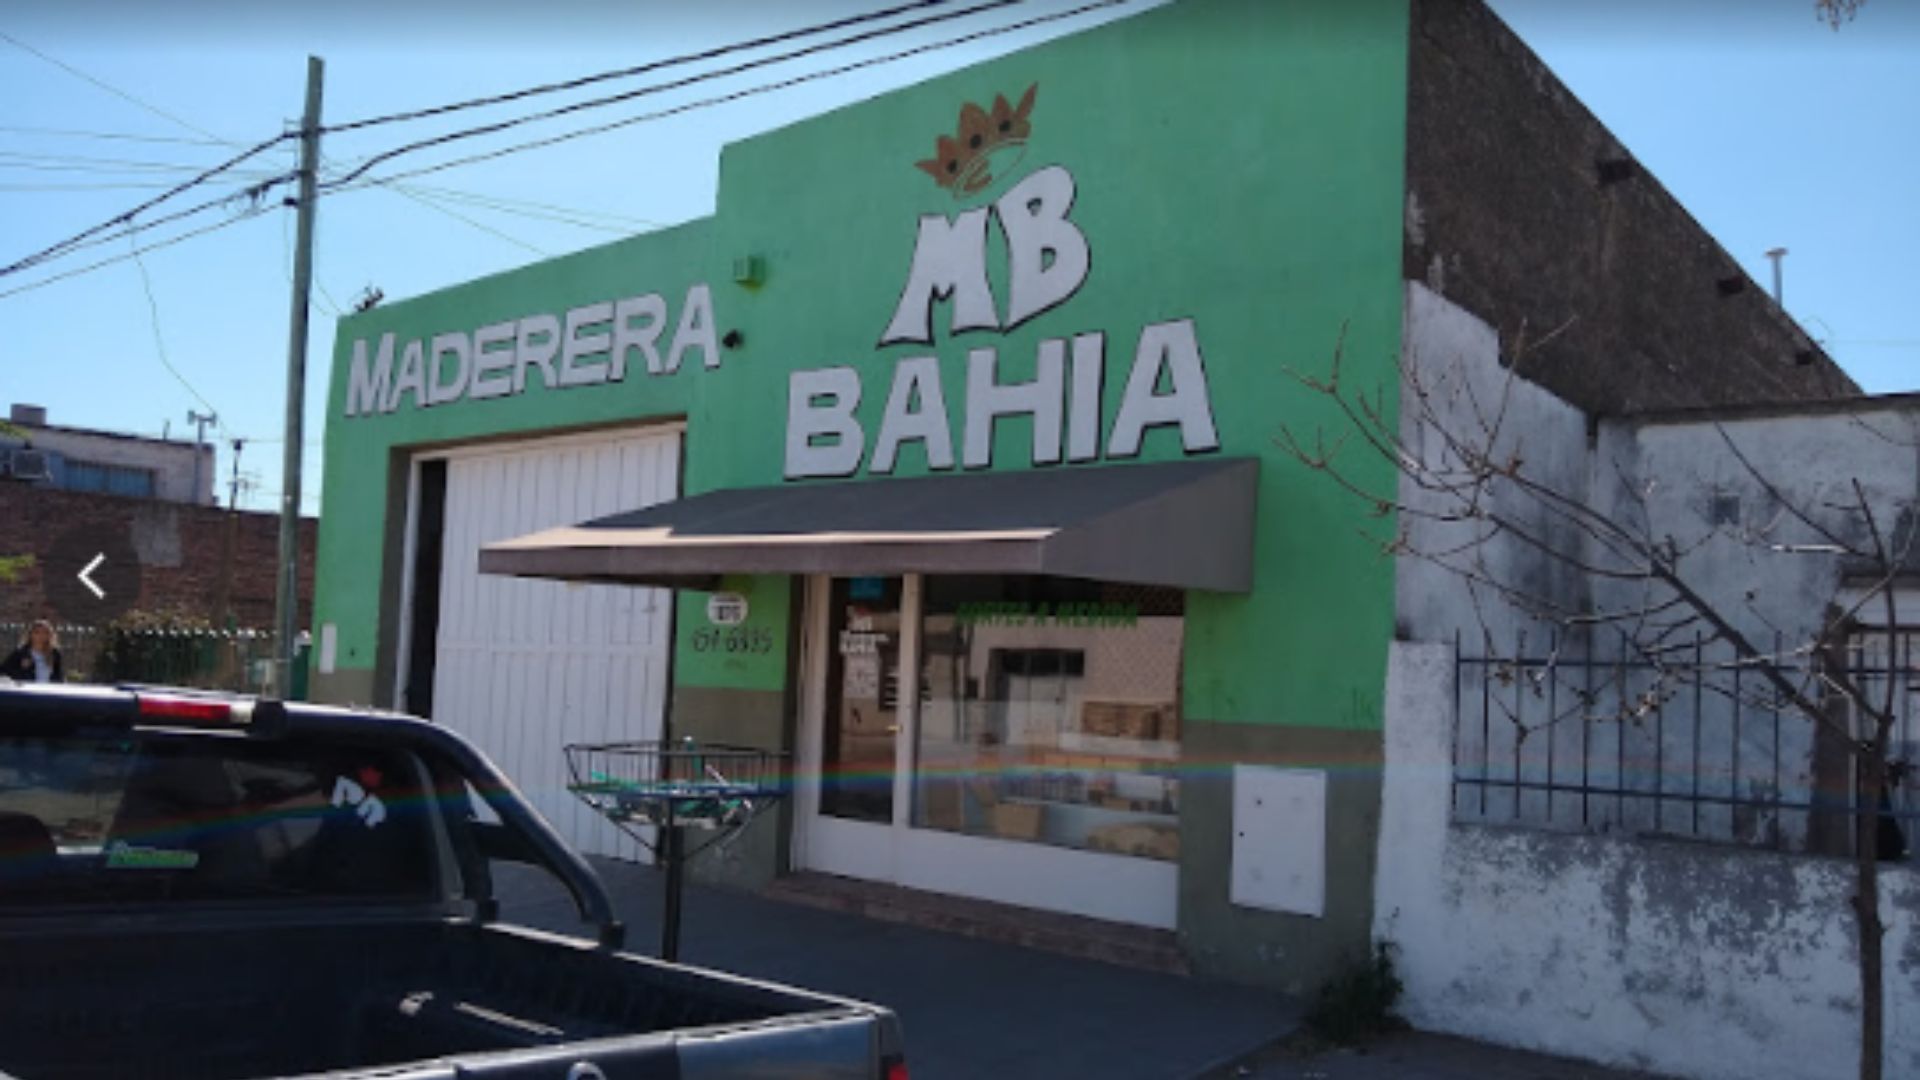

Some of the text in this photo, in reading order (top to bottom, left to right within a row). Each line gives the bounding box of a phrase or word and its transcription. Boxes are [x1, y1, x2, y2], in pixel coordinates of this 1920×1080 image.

[876, 163, 1091, 350] MB
[344, 284, 721, 417] MADERERA
[783, 318, 1222, 481] BAHIA
